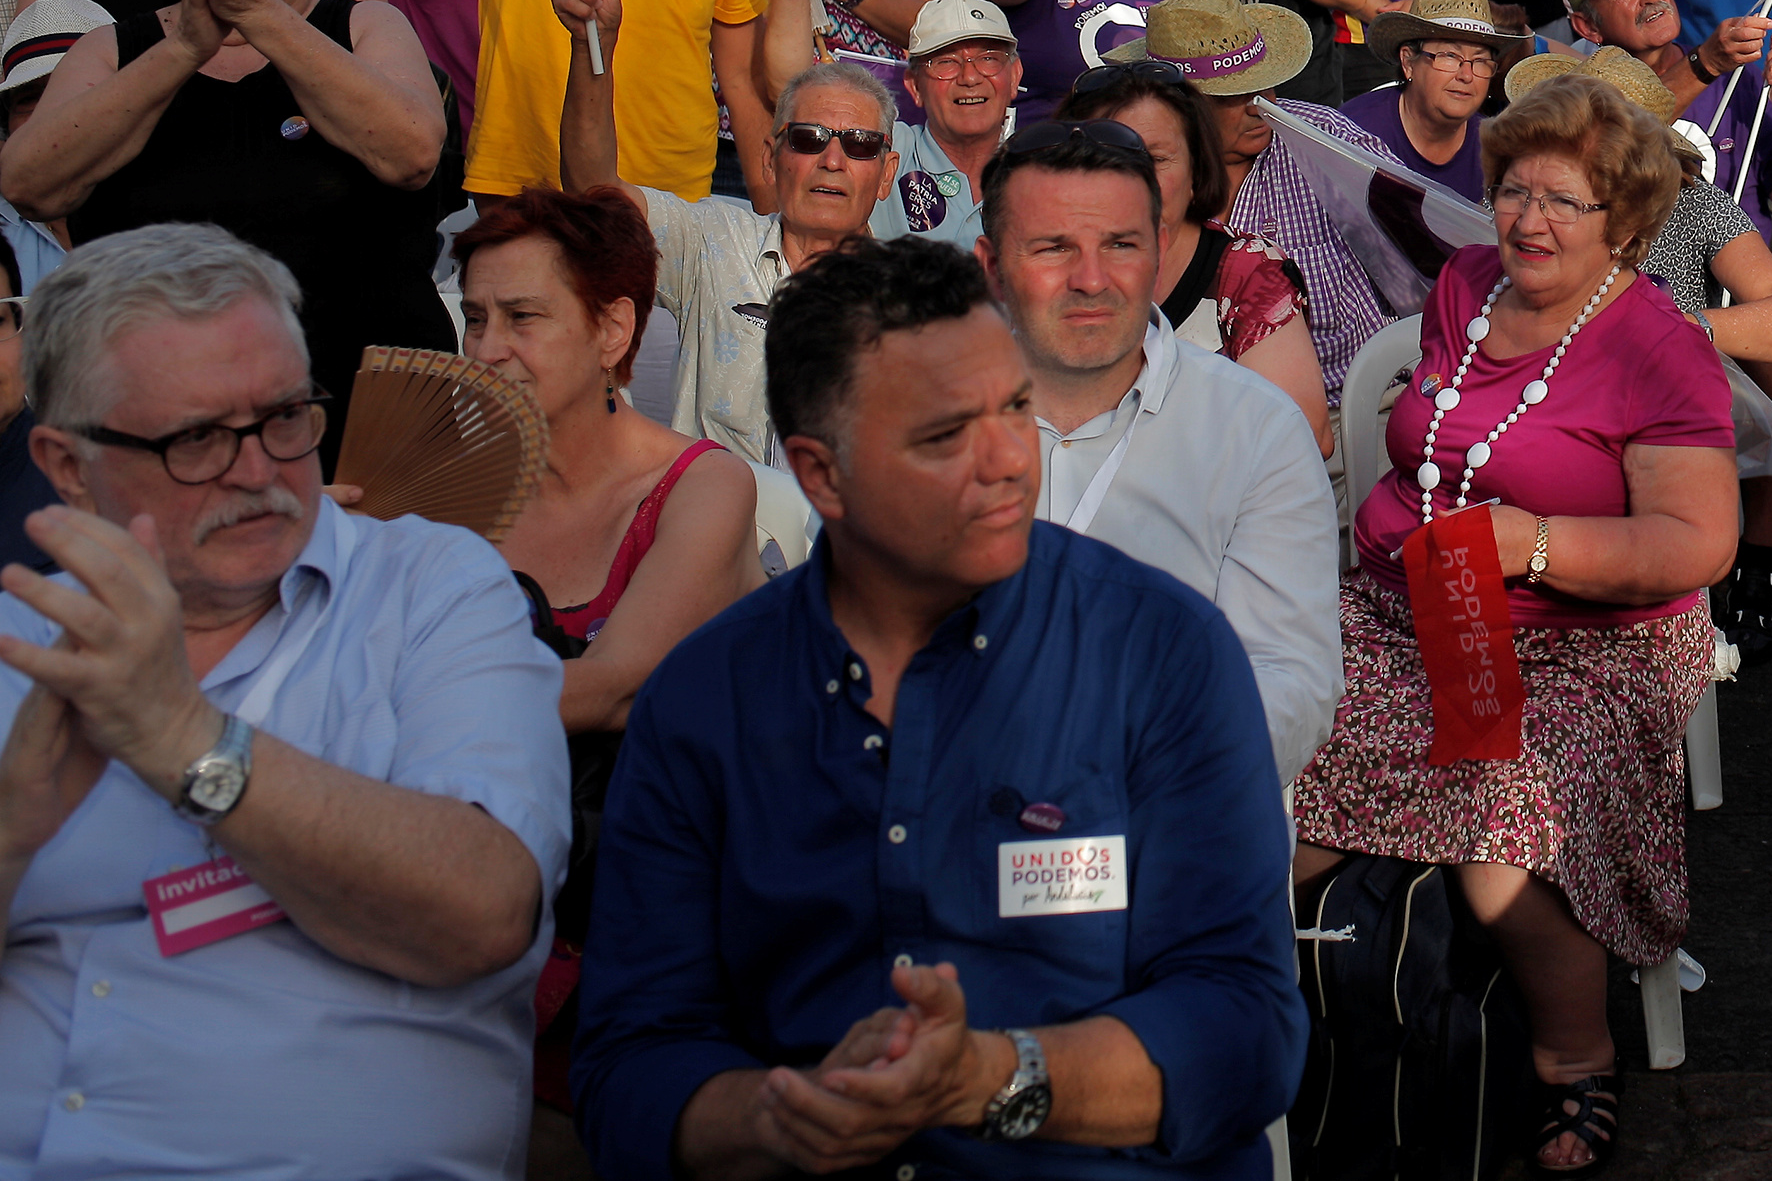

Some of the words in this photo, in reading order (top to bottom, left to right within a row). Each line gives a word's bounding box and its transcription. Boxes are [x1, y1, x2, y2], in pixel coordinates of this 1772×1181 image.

[908, 180, 938, 205] PATRIA
[921, 178, 932, 191] LA
[909, 192, 932, 210] ERES
[1012, 846, 1111, 868] UNIDOS
[1012, 865, 1116, 887] PODEMOS.
